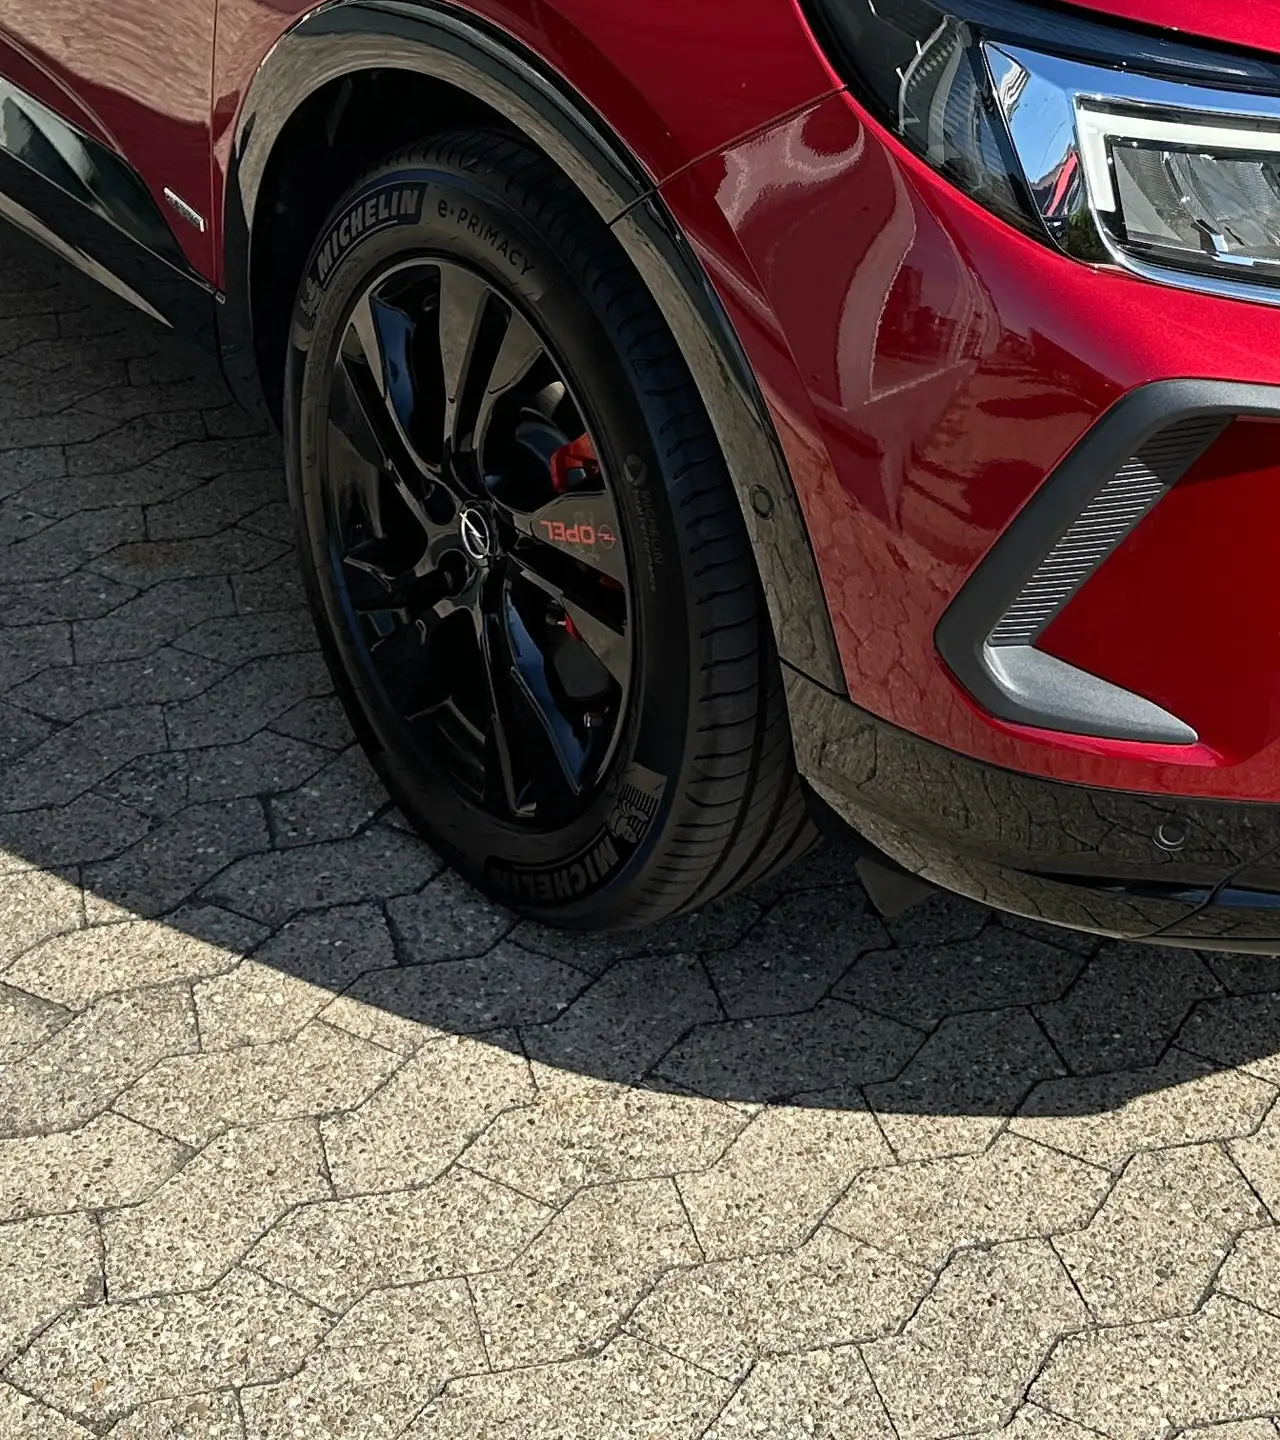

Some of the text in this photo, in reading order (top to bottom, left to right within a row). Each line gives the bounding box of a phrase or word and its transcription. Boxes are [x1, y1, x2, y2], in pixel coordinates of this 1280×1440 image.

[316, 189, 420, 281] MICHELIN
[540, 519, 596, 545] OPEL
[639, 490, 665, 565] MICHELIN
[489, 834, 620, 901] MICHELIN
